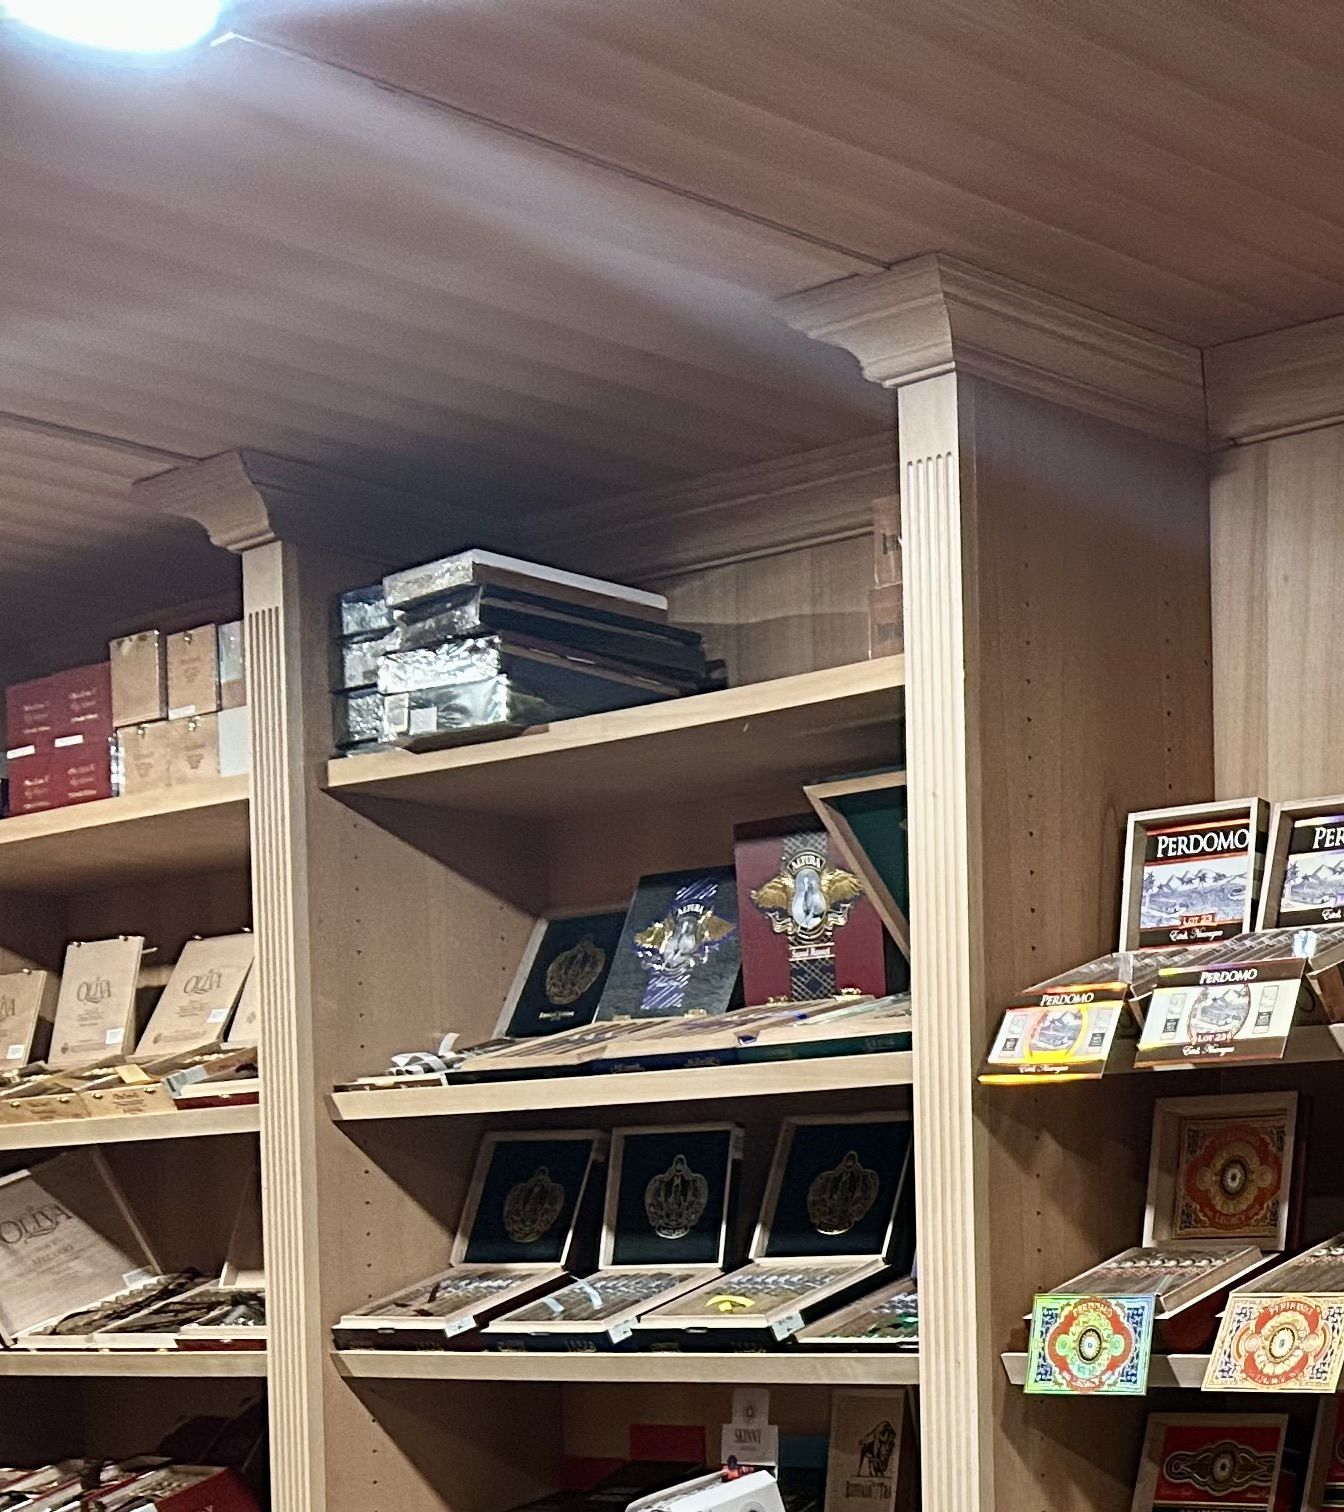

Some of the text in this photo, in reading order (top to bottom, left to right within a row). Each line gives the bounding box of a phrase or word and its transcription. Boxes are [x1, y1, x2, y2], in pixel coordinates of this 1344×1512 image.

[1156, 827, 1249, 858] PERDOMO
[1199, 968, 1258, 985] PERDOMO
[1039, 992, 1095, 1006] PERDOMO
[734, 1428, 762, 1444] SKINNY
